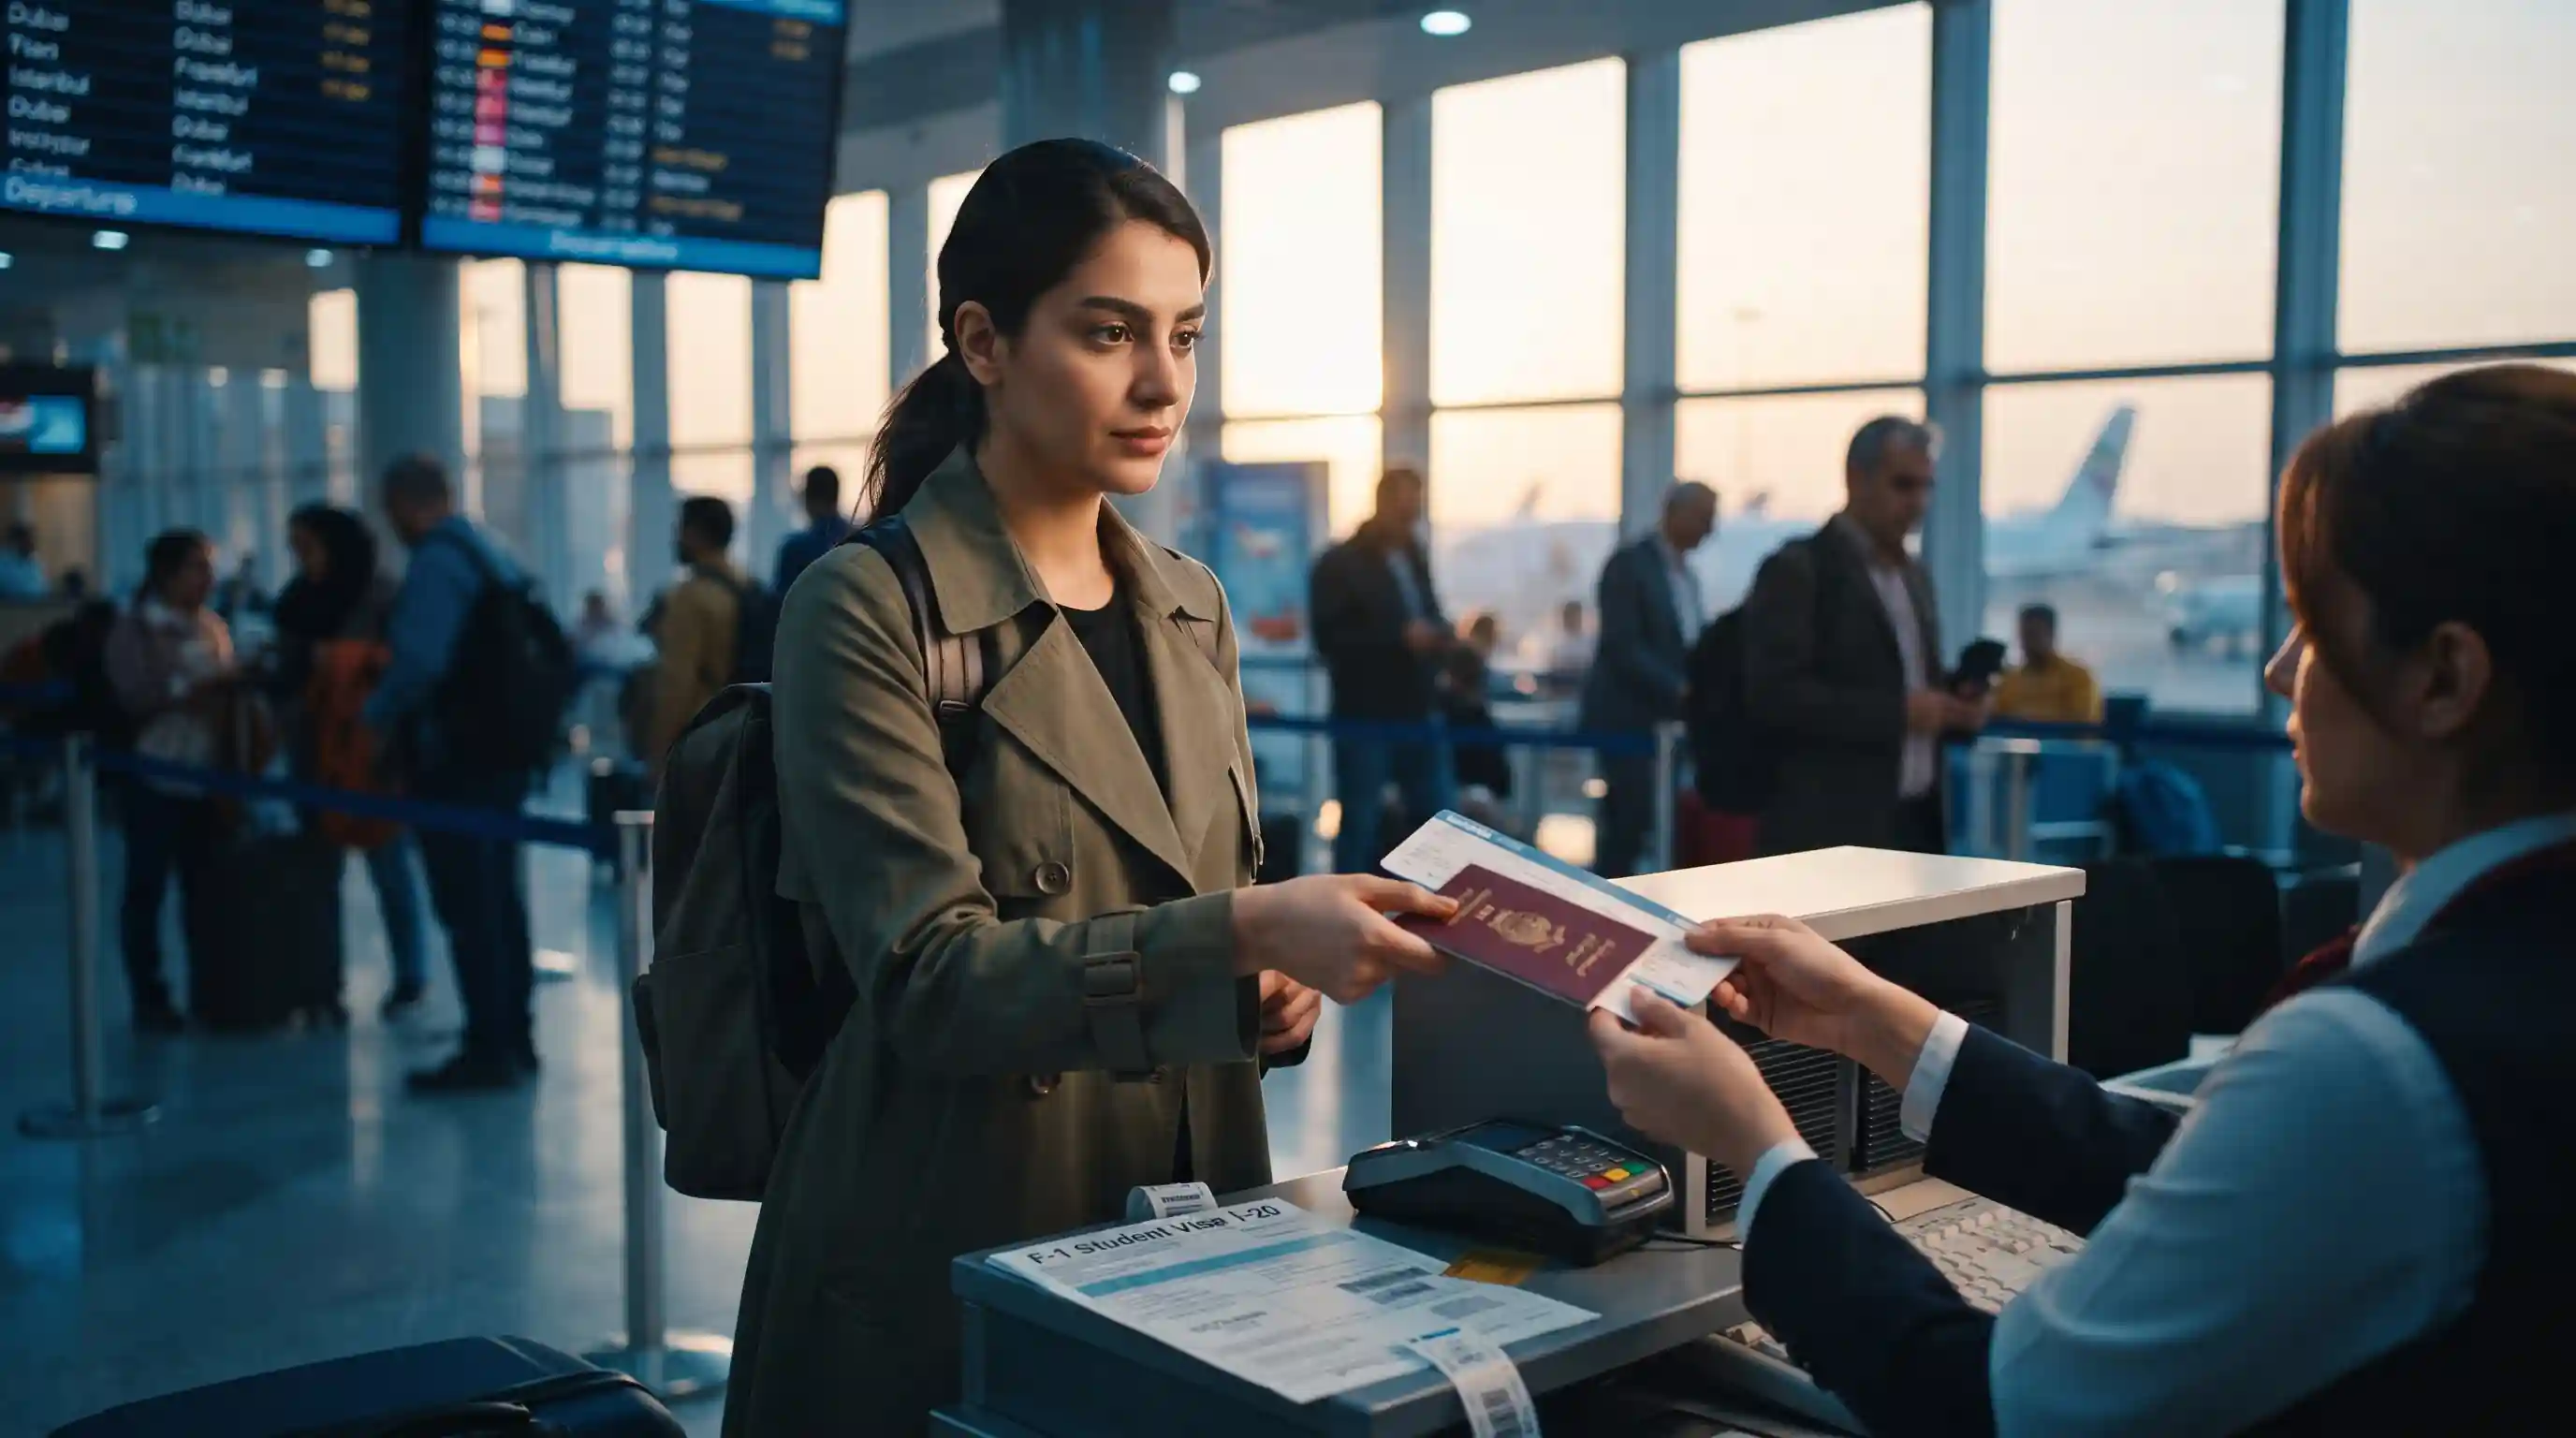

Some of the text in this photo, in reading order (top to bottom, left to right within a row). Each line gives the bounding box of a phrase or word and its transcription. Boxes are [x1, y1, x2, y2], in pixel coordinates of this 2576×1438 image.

[1027, 1205, 1281, 1264] F-1 Student Visa I-20
